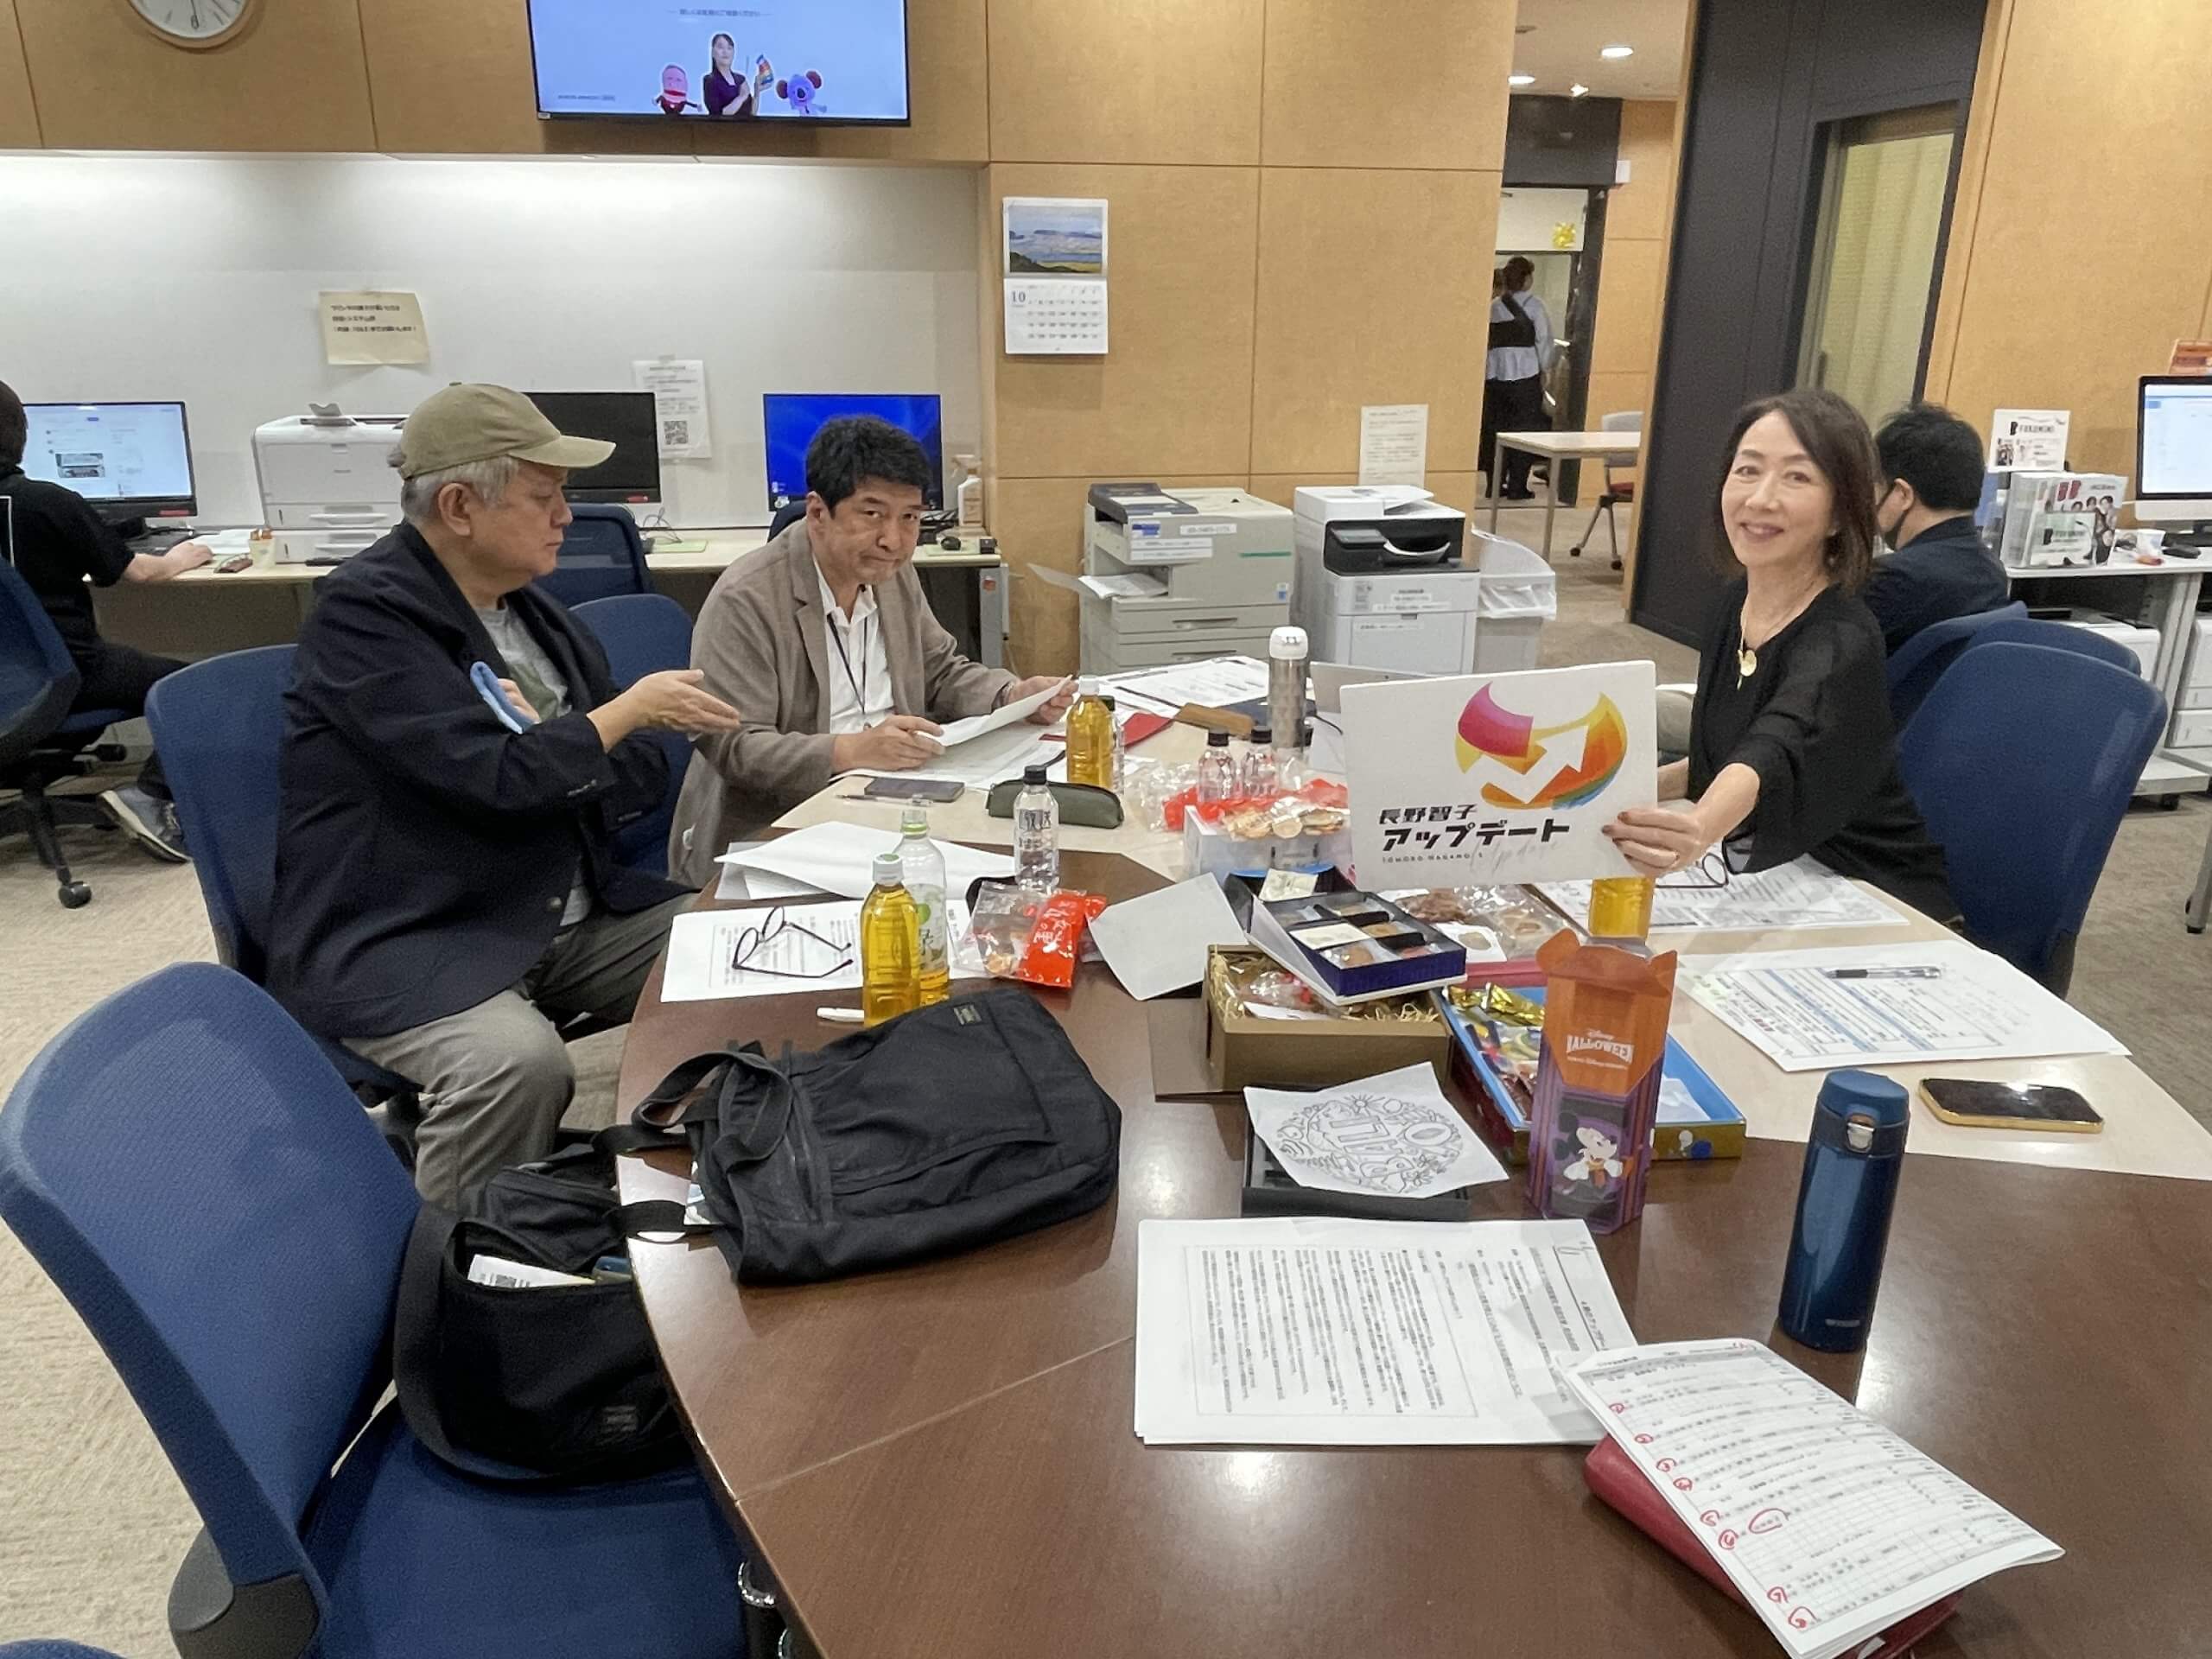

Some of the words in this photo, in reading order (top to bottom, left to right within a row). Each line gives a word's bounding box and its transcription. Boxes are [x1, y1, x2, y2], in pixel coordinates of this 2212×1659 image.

[1011, 290, 1027, 302] 10
[1379, 804, 1478, 824] 長野智子
[1382, 818, 1570, 852] アップデート
